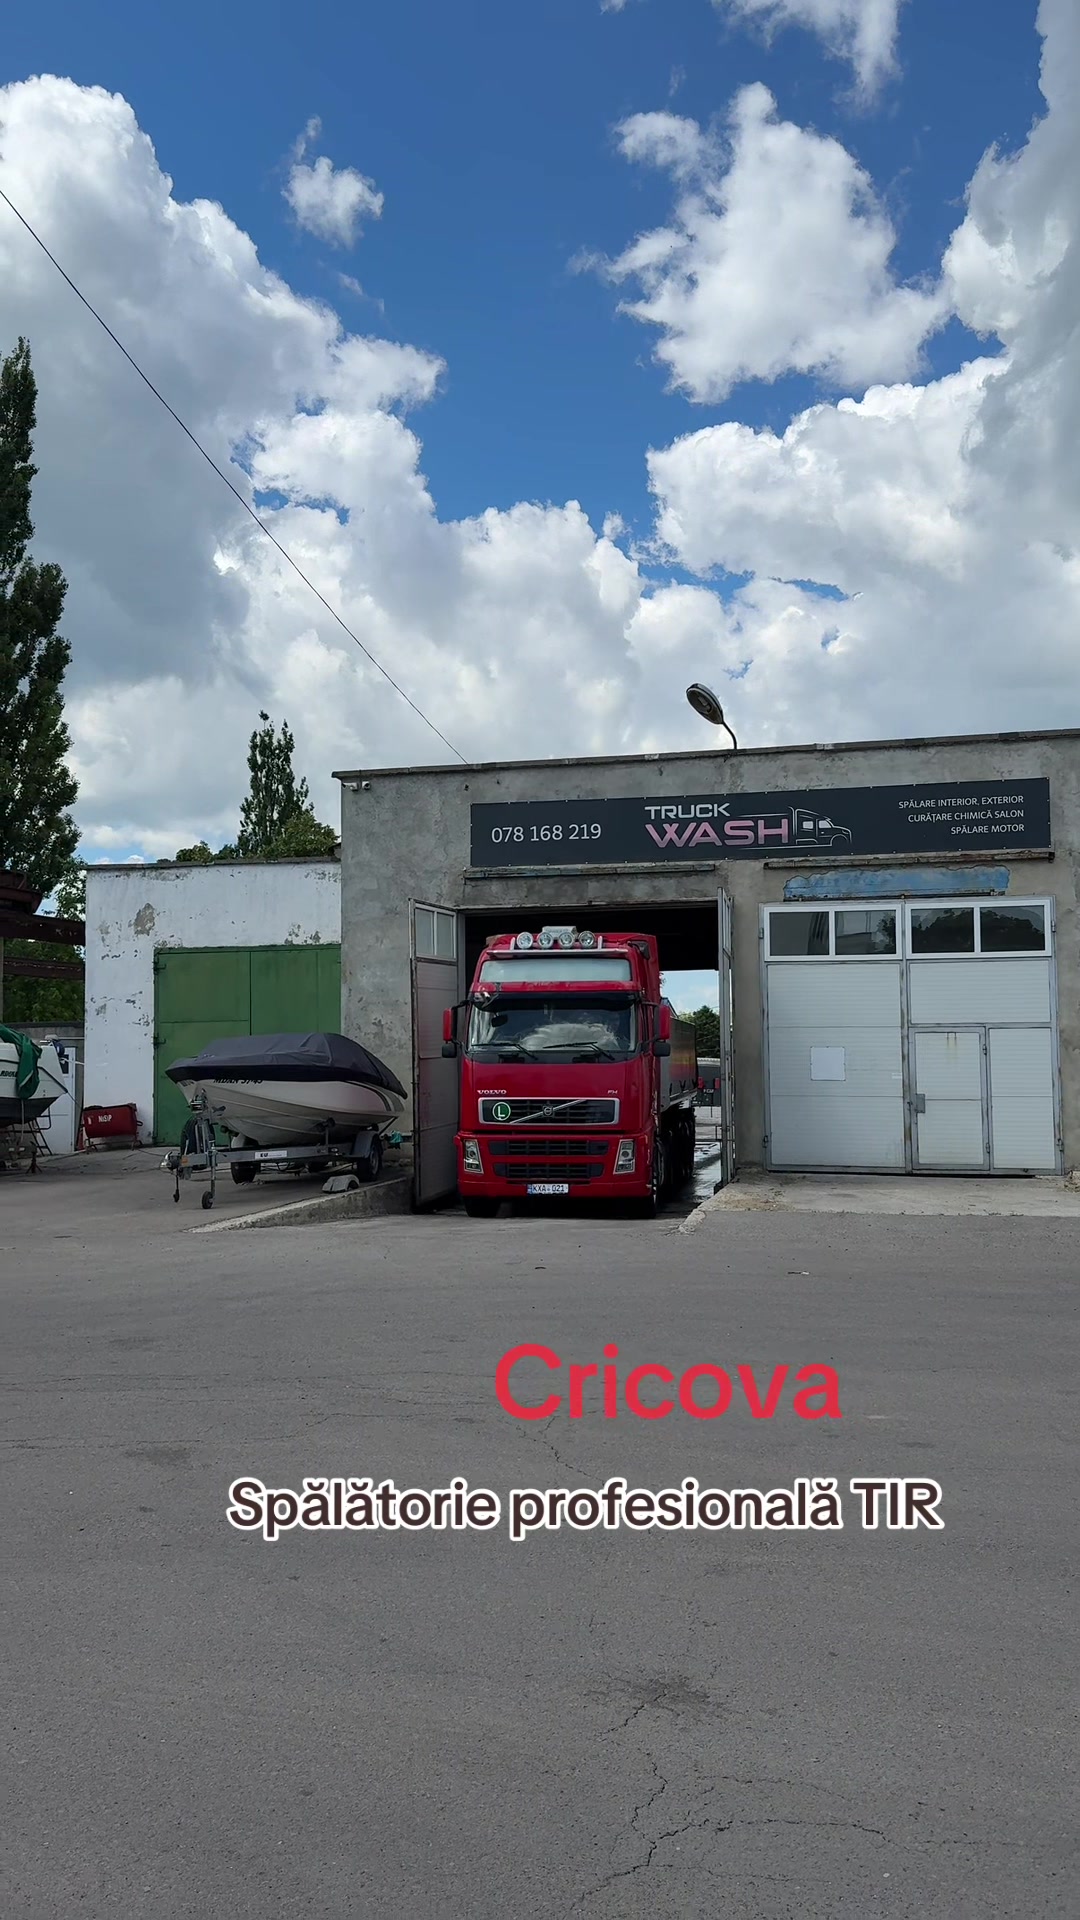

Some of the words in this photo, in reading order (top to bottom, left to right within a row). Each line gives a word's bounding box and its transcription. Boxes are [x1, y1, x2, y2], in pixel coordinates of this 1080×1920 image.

[898, 799, 936, 809] SPĂLARE
[981, 795, 1024, 805] EXTERIOR
[644, 803, 731, 820] TRUCK
[954, 810, 993, 821] CHIMICĂ
[994, 809, 1024, 819] SALON
[491, 827, 525, 843] 078
[529, 825, 563, 842] 168
[568, 823, 602, 840] 219
[645, 818, 789, 848] WASH
[950, 825, 989, 835] SPĂLARE
[991, 823, 1025, 833] MOTOR
[498, 1105, 506, 1118] L
